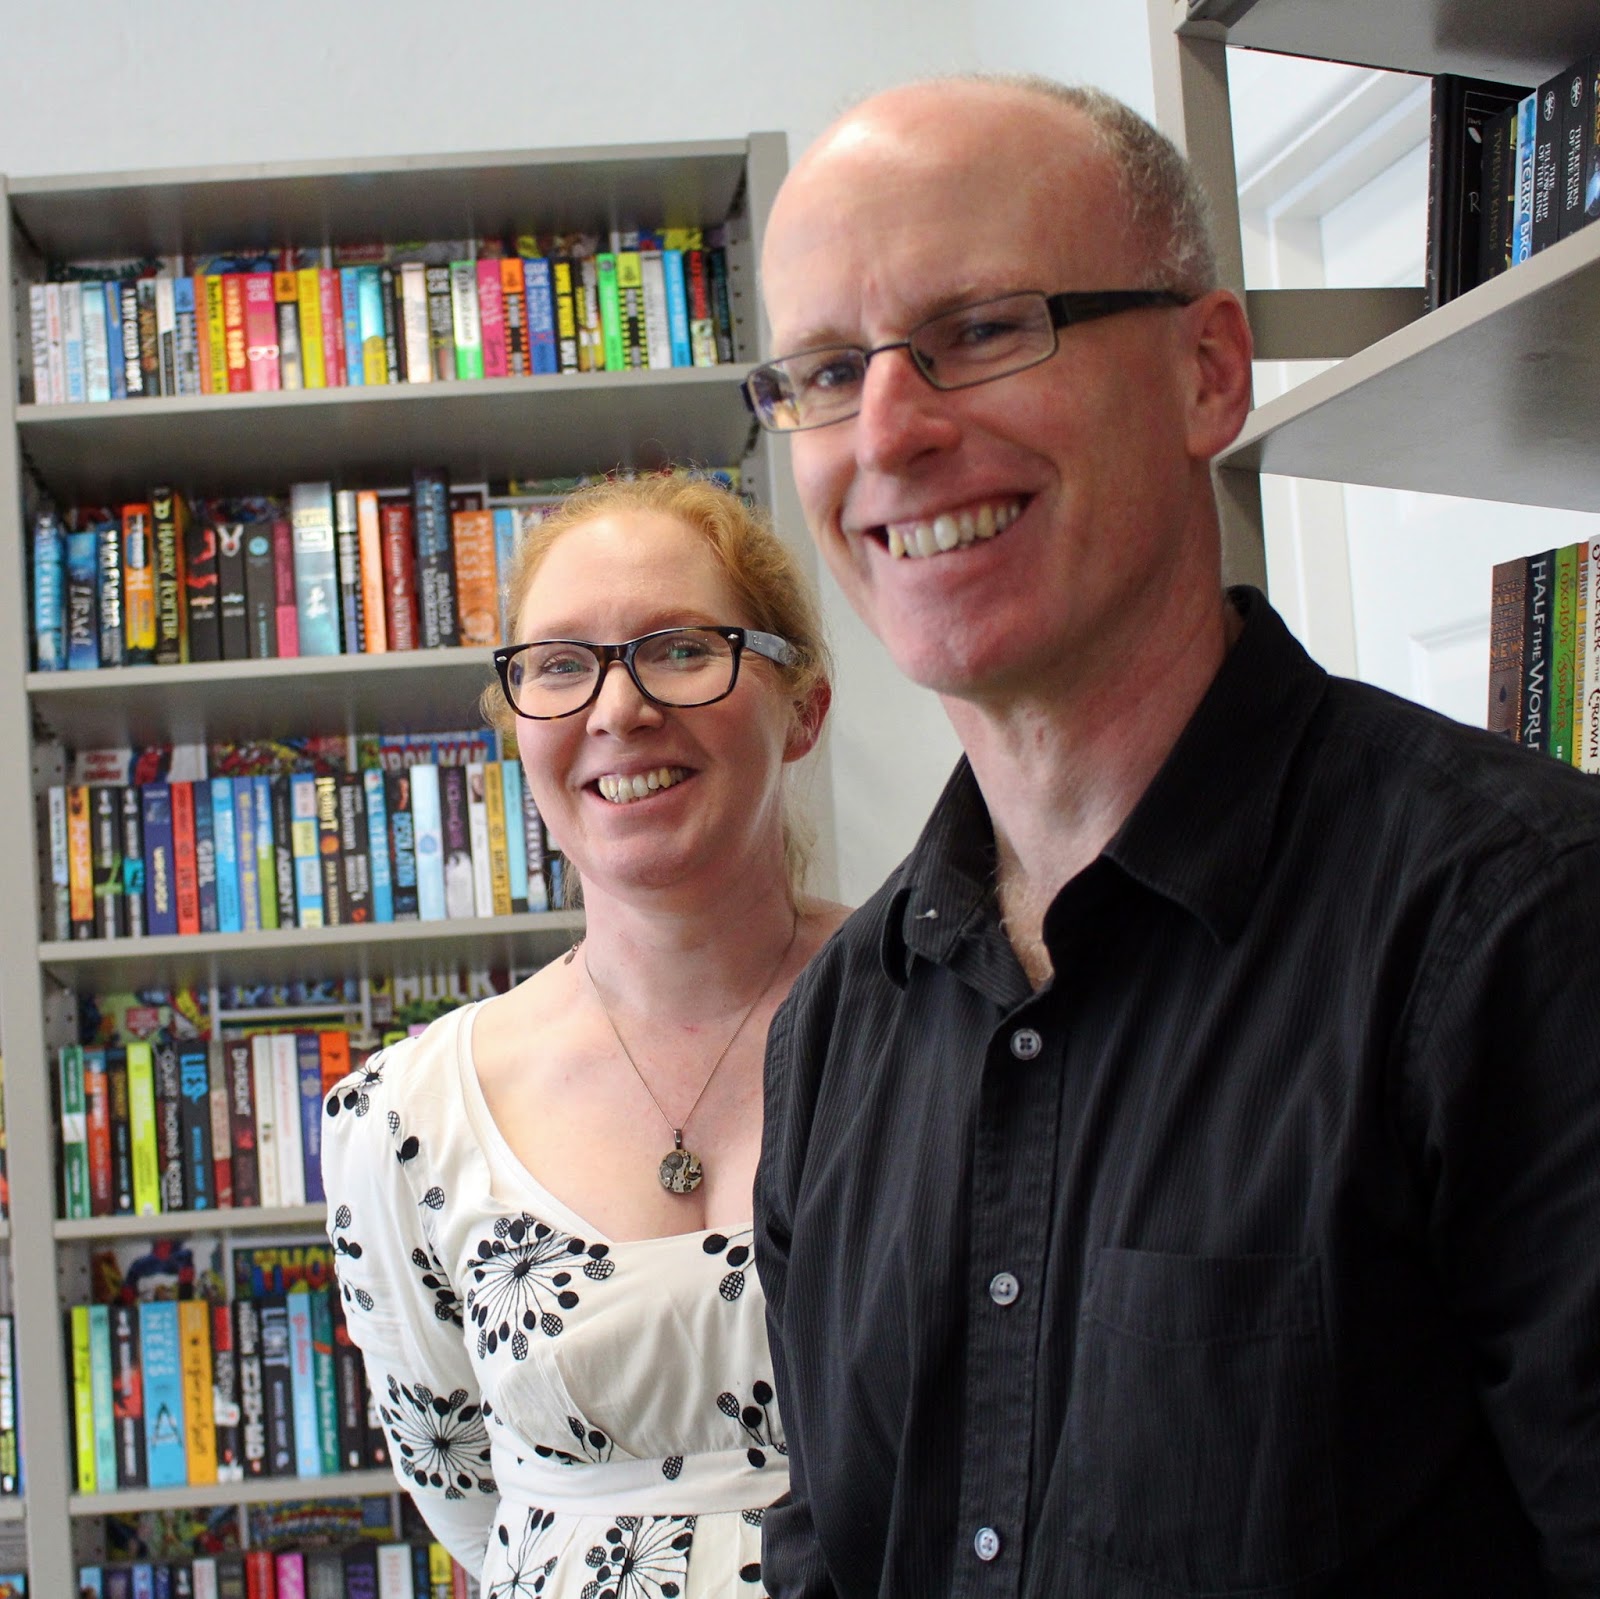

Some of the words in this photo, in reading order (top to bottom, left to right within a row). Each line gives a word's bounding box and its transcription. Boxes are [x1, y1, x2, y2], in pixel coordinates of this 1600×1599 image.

[1573, 125, 1582, 151] THE
[1520, 154, 1533, 217] TERRY
[1542, 143, 1552, 218] FELLOWSHIP
[1566, 177, 1574, 210] KING
[1572, 153, 1580, 206] RETURN
[1535, 191, 1543, 223] RING
[1531, 560, 1547, 626] HALF
[1532, 627, 1542, 661] THE
[180, 1054, 207, 1098] LIES
